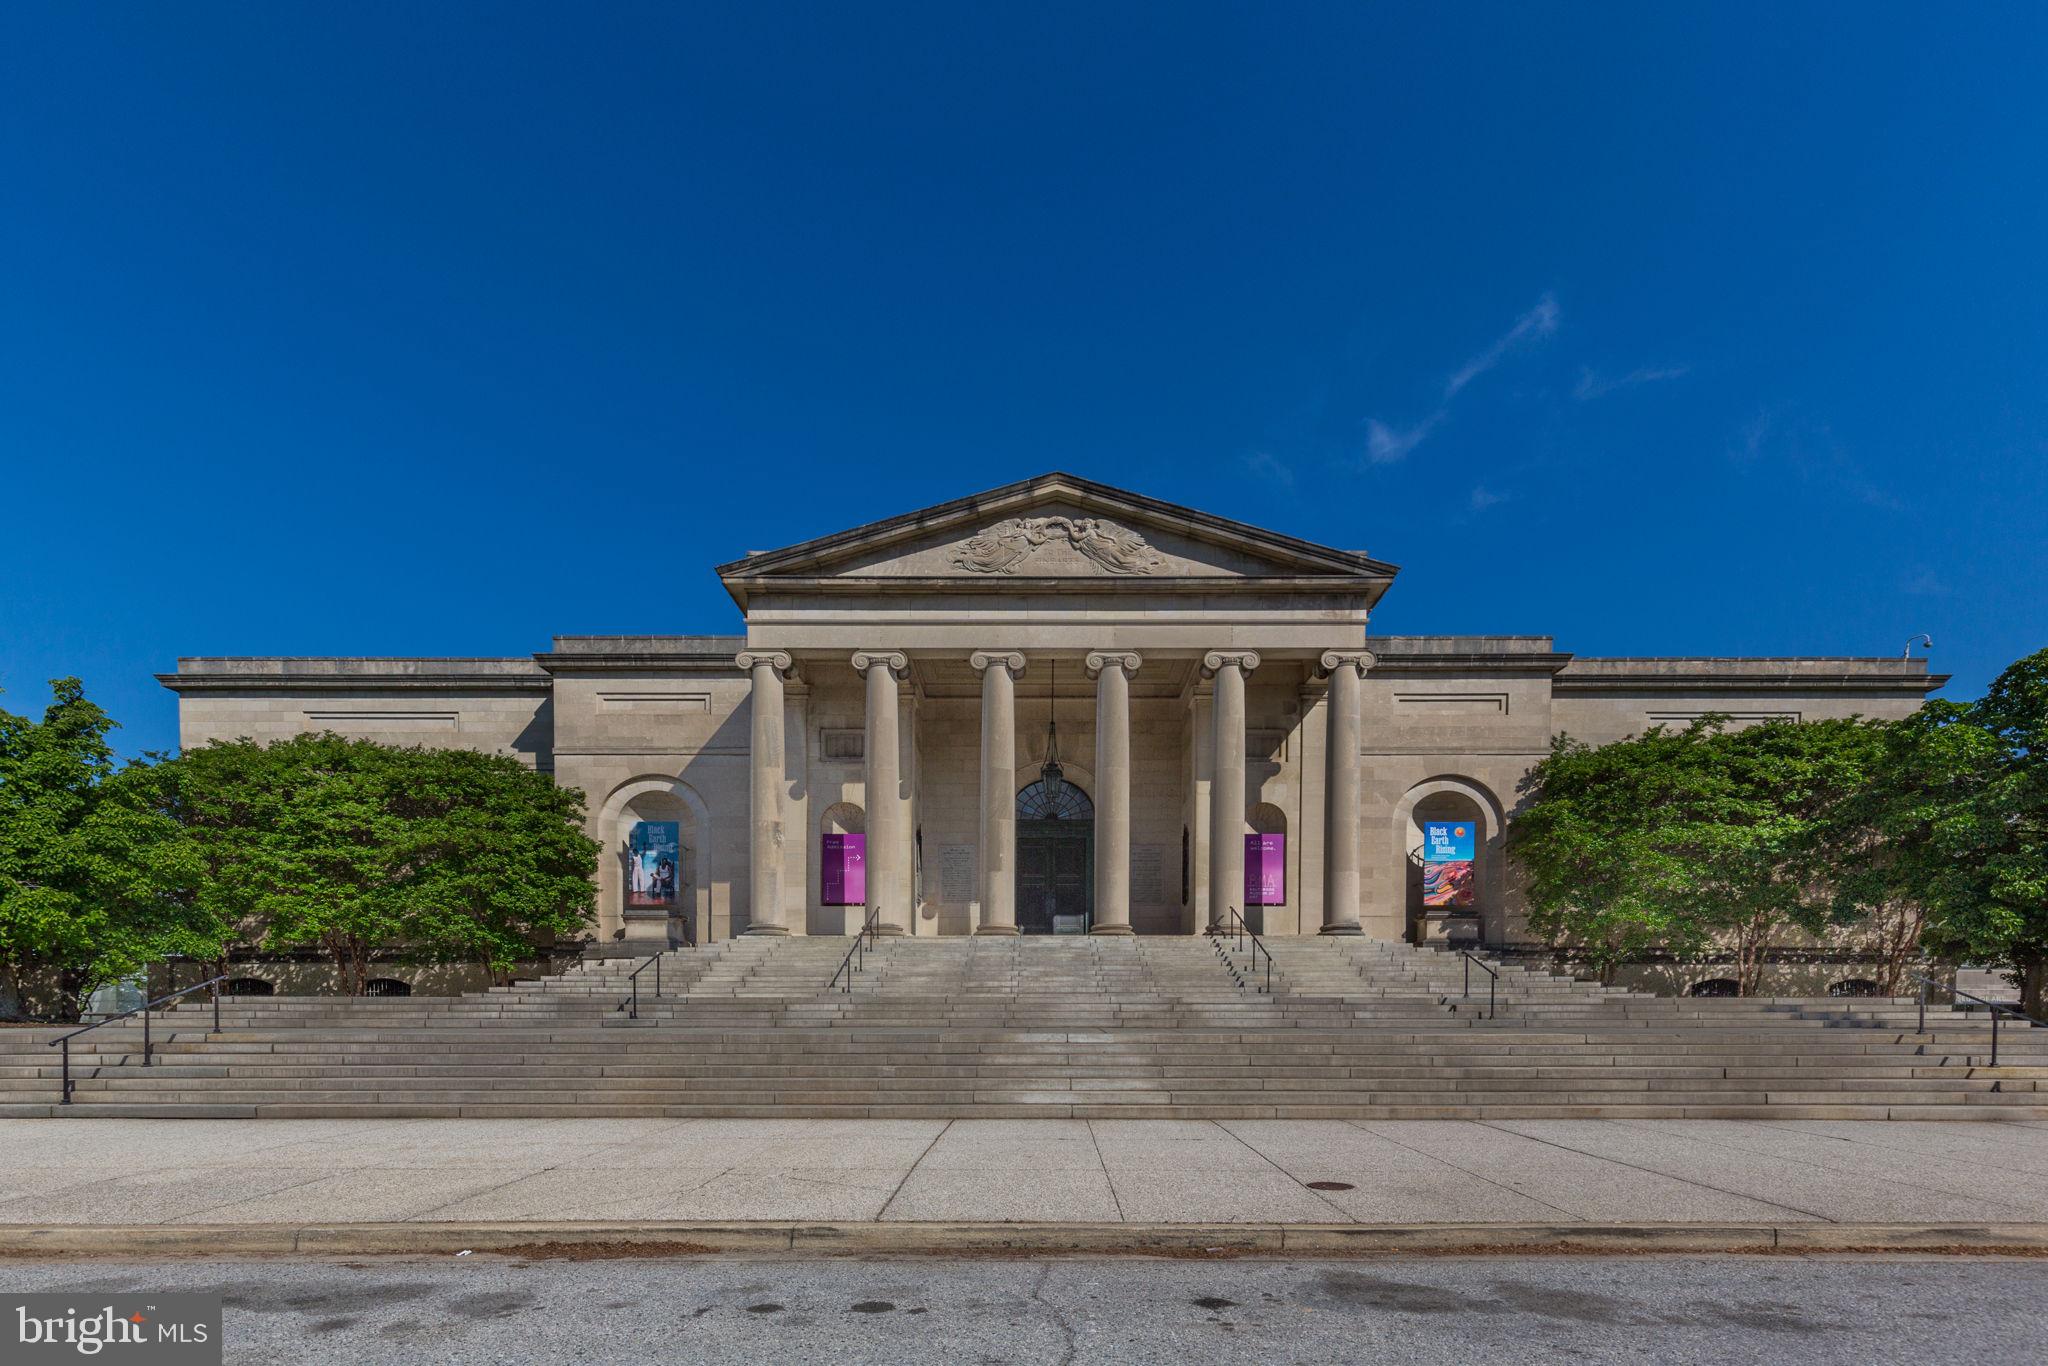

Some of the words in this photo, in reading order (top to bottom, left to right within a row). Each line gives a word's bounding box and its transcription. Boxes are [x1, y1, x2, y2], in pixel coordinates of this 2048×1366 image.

[648, 825, 665, 834] Black
[1430, 827, 1448, 836] Black
[649, 834, 667, 843] Earth
[1431, 836, 1449, 845] Earth
[1436, 845, 1456, 855] Rising
